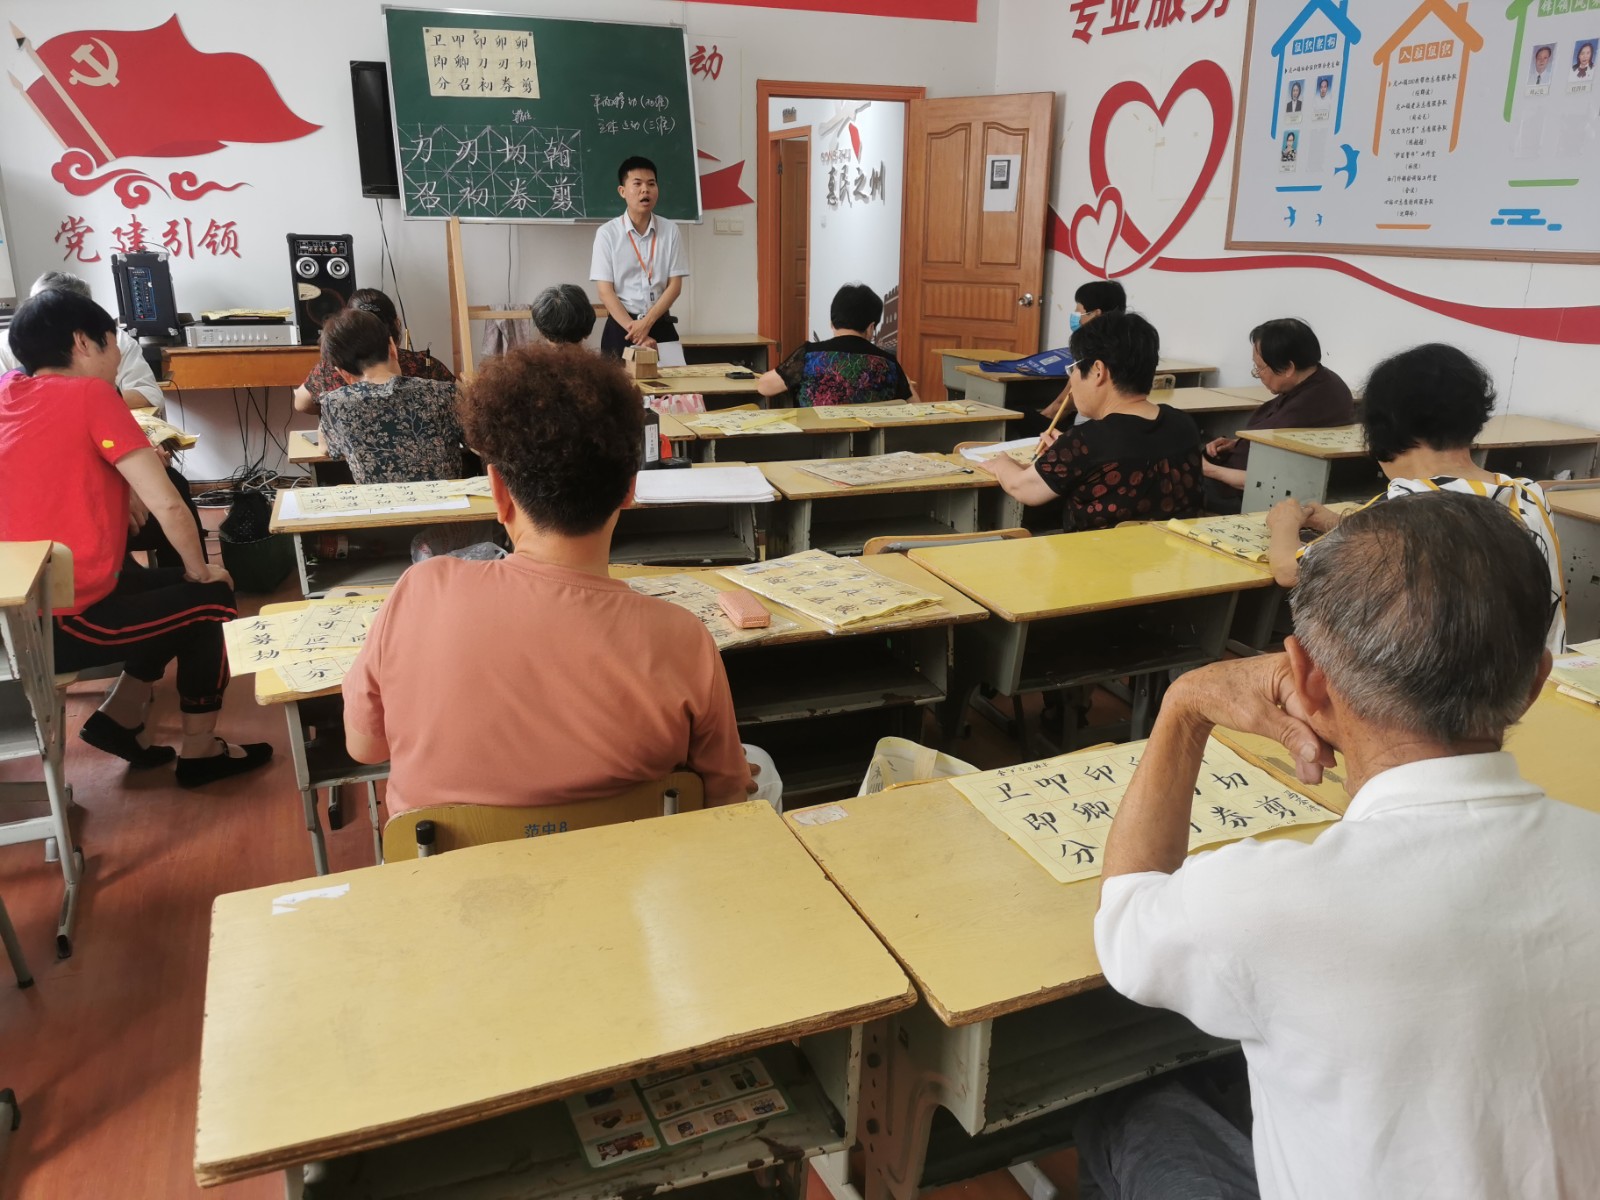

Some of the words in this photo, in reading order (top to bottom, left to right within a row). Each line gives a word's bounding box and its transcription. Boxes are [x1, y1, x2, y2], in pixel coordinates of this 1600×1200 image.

[689, 45, 723, 80] 动
[54, 213, 242, 262] 党建引领
